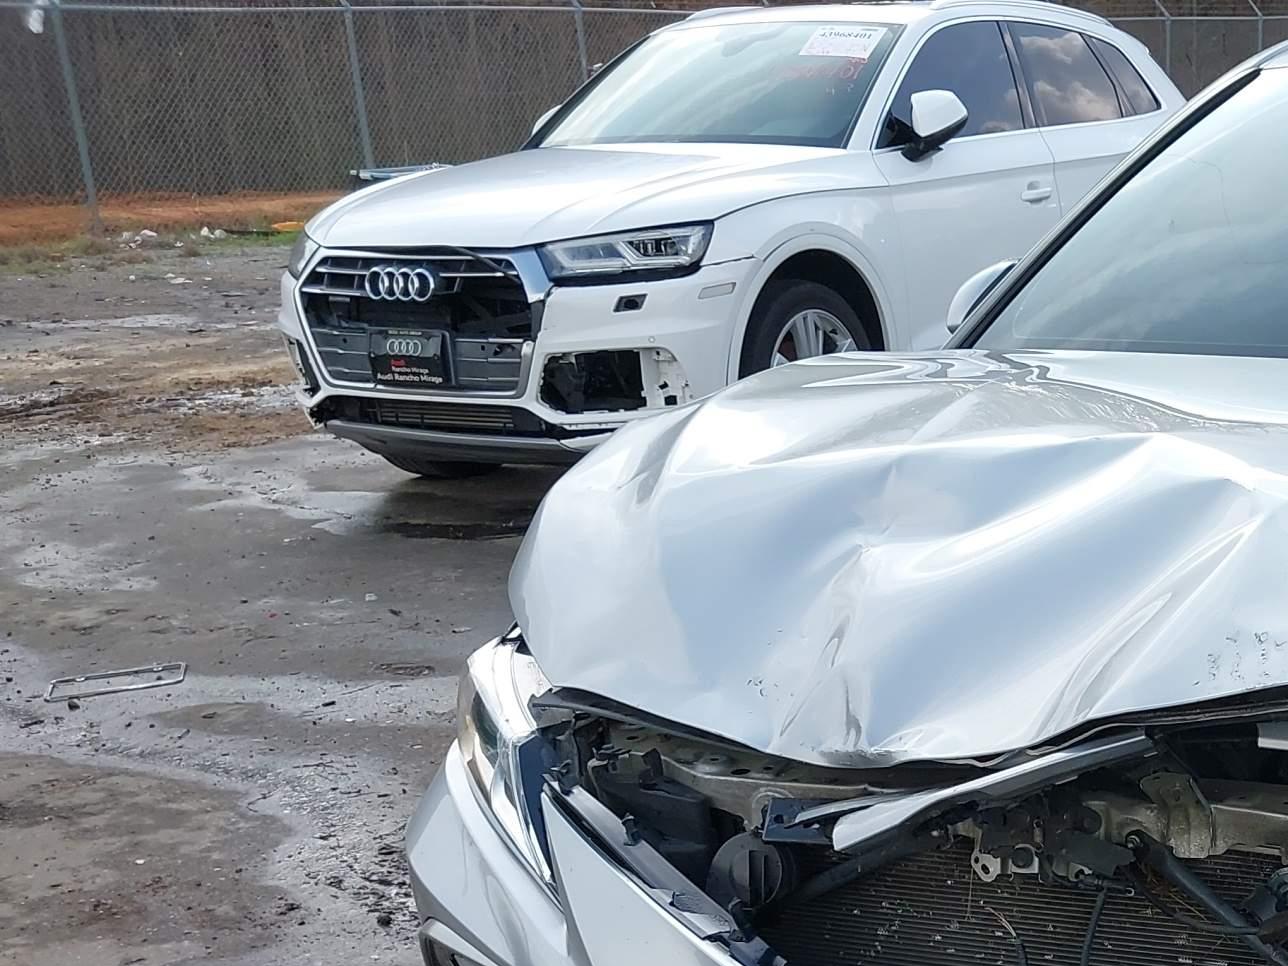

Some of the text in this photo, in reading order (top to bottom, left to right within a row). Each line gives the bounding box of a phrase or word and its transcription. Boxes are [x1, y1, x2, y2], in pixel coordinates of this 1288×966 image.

[377, 373, 443, 384] Audi Rancho Mirage
